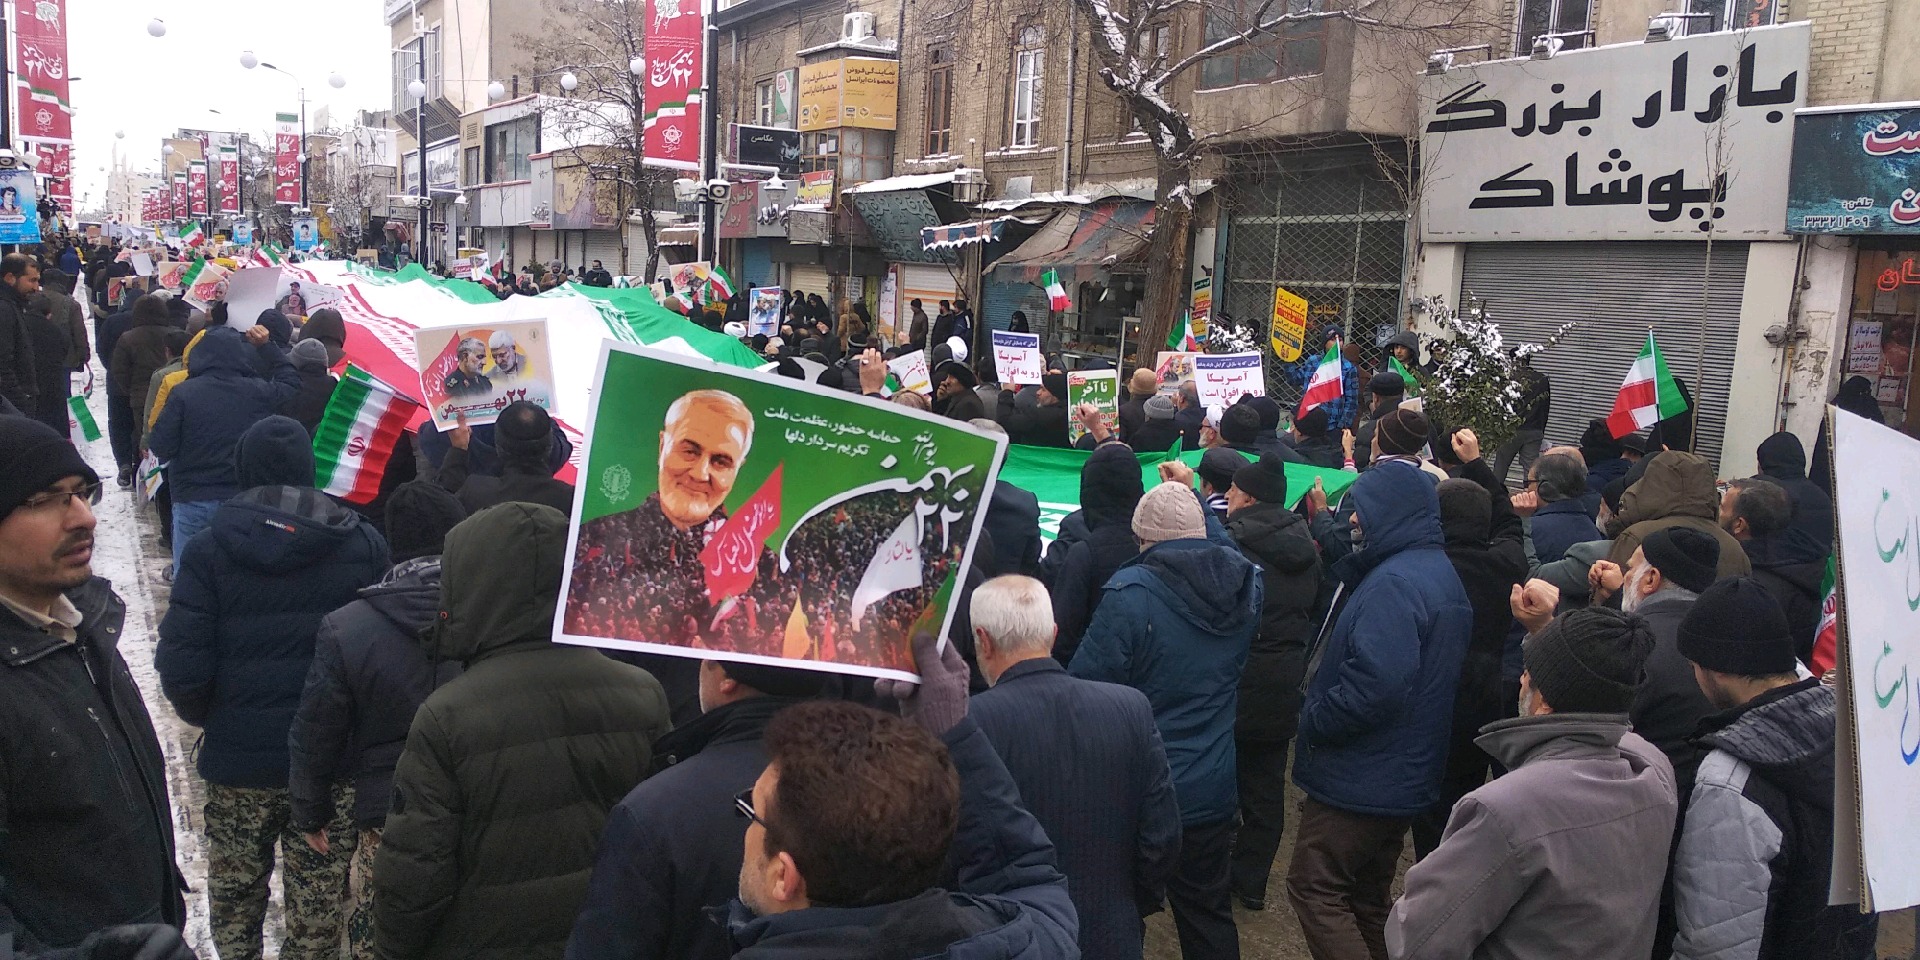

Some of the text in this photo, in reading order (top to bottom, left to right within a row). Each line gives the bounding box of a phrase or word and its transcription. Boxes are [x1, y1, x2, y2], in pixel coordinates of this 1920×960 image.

[673, 68, 692, 88] ۲۲
[802, 72, 838, 85] نمایندگی فروش
[865, 67, 895, 76] نمایندگی
[846, 76, 894, 85] محصولات ایرانسل
[818, 84, 837, 94] محصولات
[1425, 43, 1798, 138] بازار بزرگ
[750, 134, 774, 142] عکاسی
[808, 173, 833, 191] عکاسی
[1468, 148, 1728, 232] پوشاک
[1804, 216, 1870, 228] ۳۳۳۲۱۴۰۹
[1278, 295, 1291, 304] آمریکا
[998, 350, 1028, 364] آمریکا
[1006, 366, 1020, 378] افول
[1020, 370, 1028, 378] به
[1206, 370, 1248, 385] آمریکا
[1081, 380, 1099, 397] آخر
[1100, 381, 1108, 392] تا
[506, 388, 526, 404] ۲۲
[1222, 388, 1239, 400] افول
[441, 398, 507, 420] بهمن
[764, 407, 789, 420] ملت
[790, 412, 828, 428] عظمت
[784, 428, 870, 456] تکریم سردار دلها
[867, 428, 902, 444] حماسه
[780, 454, 974, 574] بهمن
[914, 498, 964, 553] ۲۲
